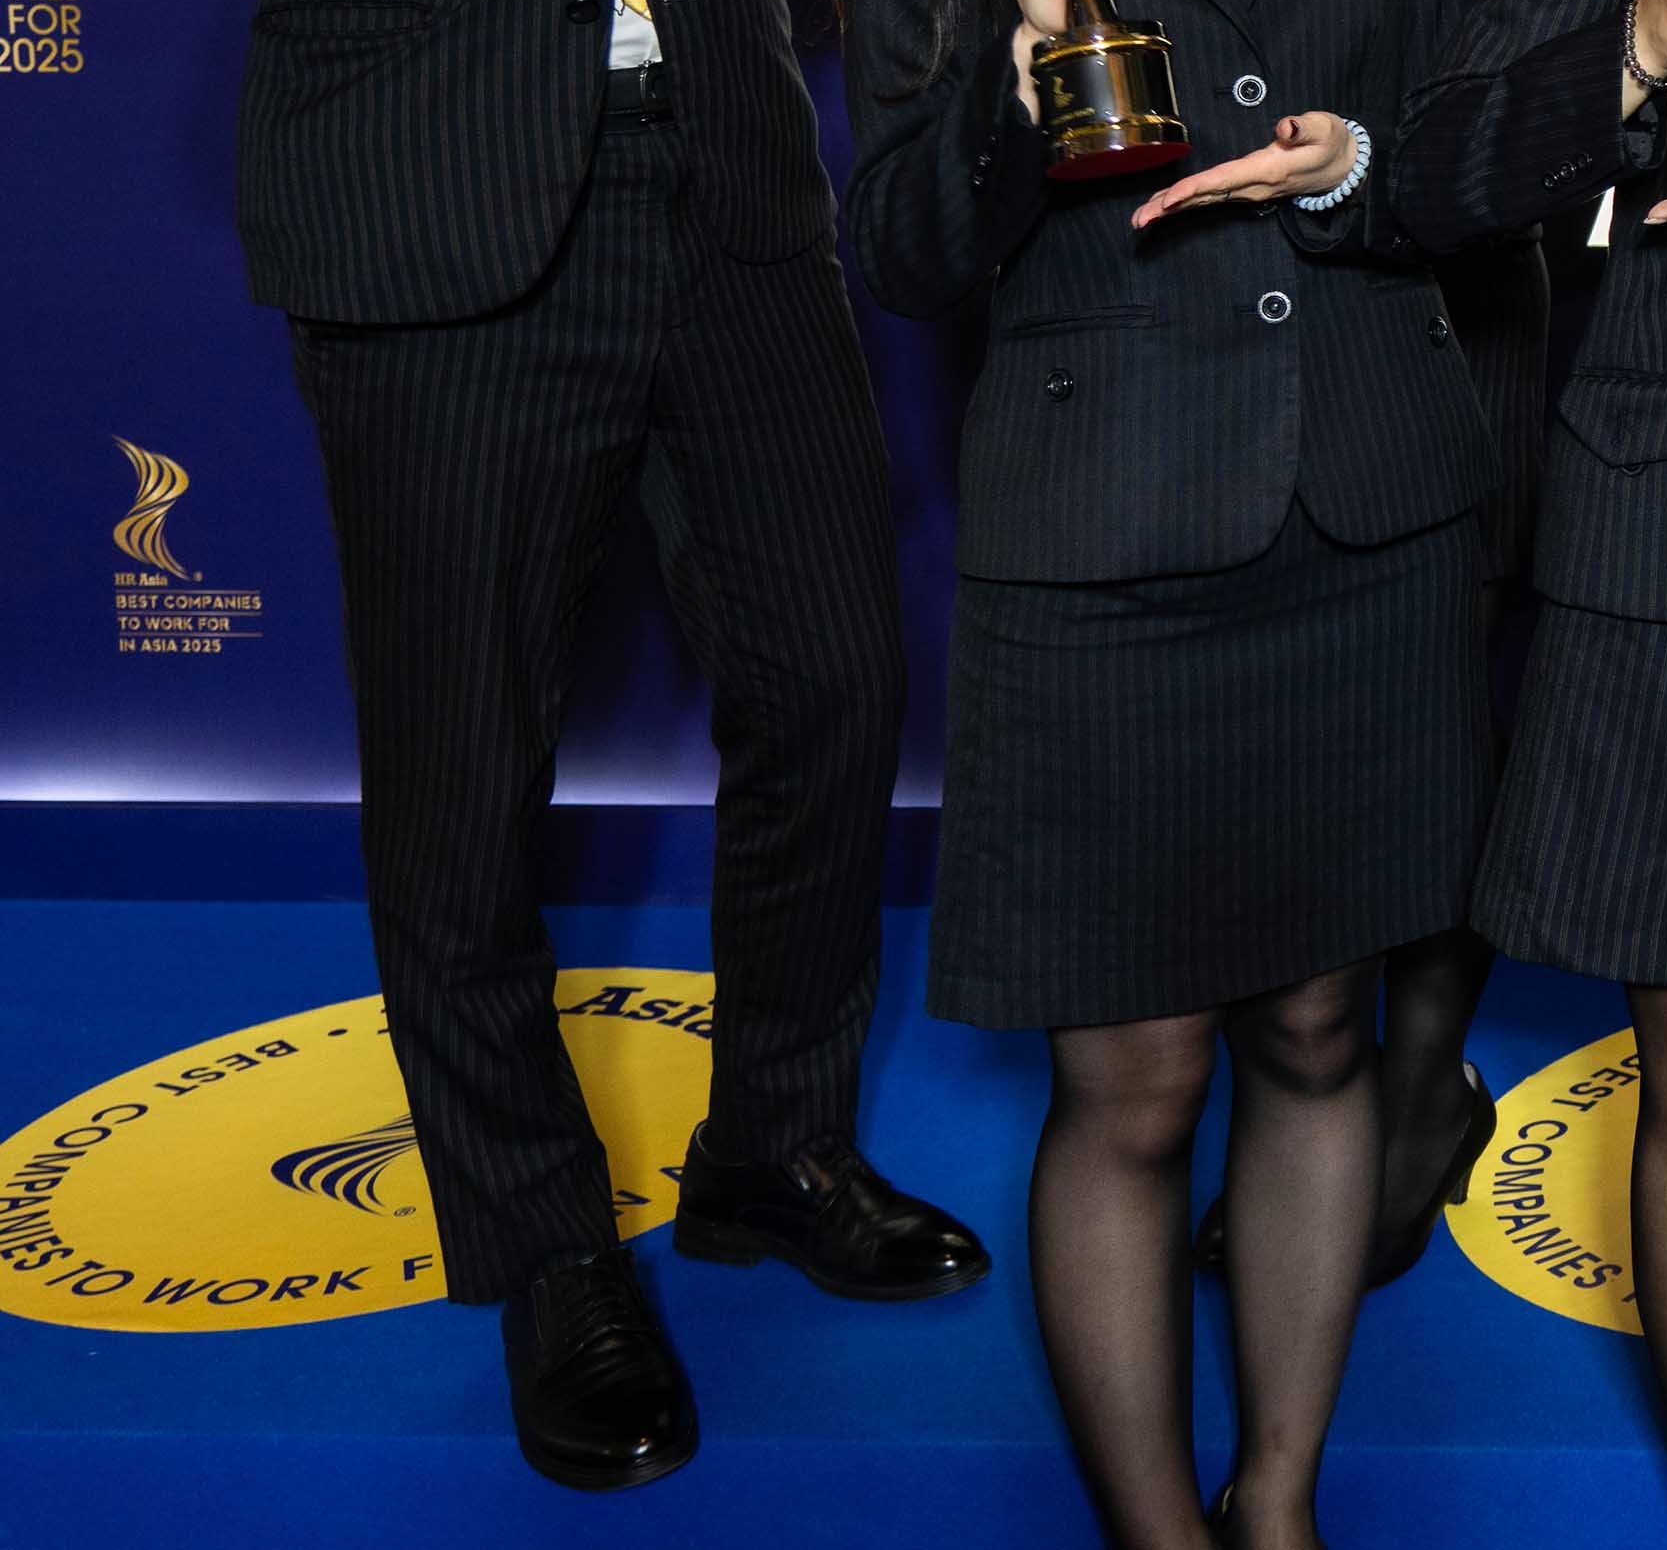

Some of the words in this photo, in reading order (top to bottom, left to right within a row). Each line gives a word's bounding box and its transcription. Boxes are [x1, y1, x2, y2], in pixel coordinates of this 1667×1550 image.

[8, 4, 81, 35] FOR
[139, 572, 168, 586] Asia
[116, 595, 158, 609] BEST
[164, 596, 262, 610] COMPANIES
[118, 617, 140, 631] TO
[145, 617, 193, 631] WORK
[198, 617, 230, 631] FOR
[119, 639, 135, 652] IN
[140, 639, 177, 652] ASIA
[181, 639, 222, 652] 2025
[154, 1039, 299, 1097] BEST
[1492, 1120, 1623, 1289] COMPANIES
[44, 1260, 135, 1296] TO
[143, 1266, 373, 1305] WORK
